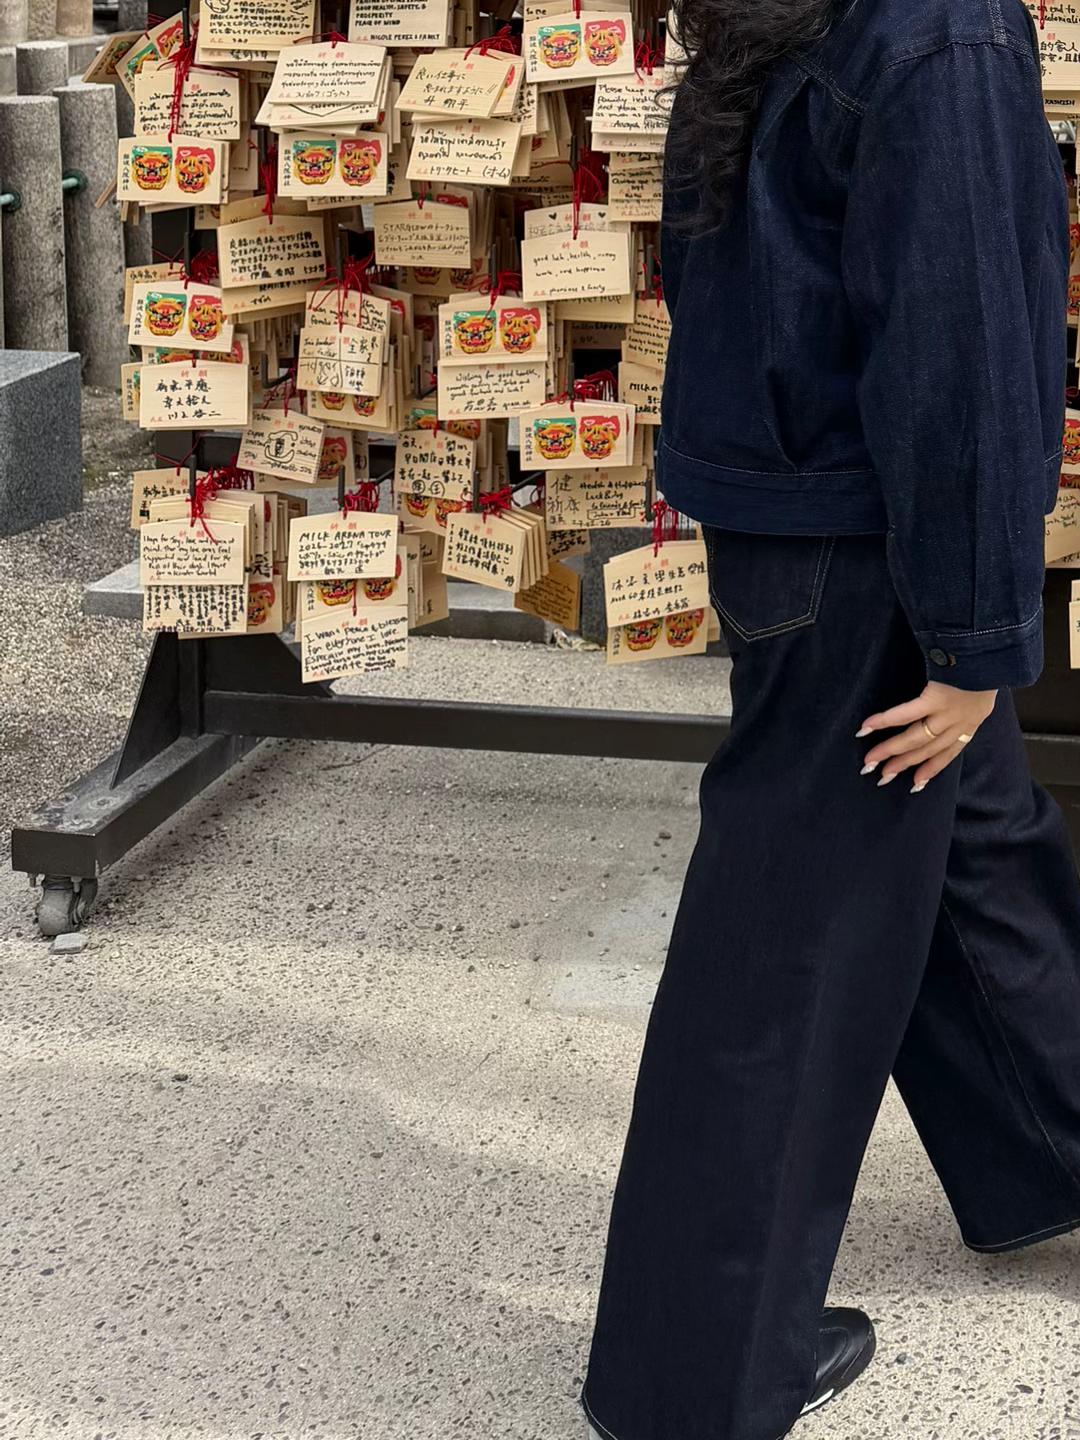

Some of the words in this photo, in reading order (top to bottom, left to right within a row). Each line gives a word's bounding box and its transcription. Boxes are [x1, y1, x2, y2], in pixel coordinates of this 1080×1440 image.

[355, 11, 393, 19] PROSPERITY
[370, 33, 392, 41] NICOLE
[394, 33, 412, 41] PEREZ
[368, 529, 392, 538] TOUR
